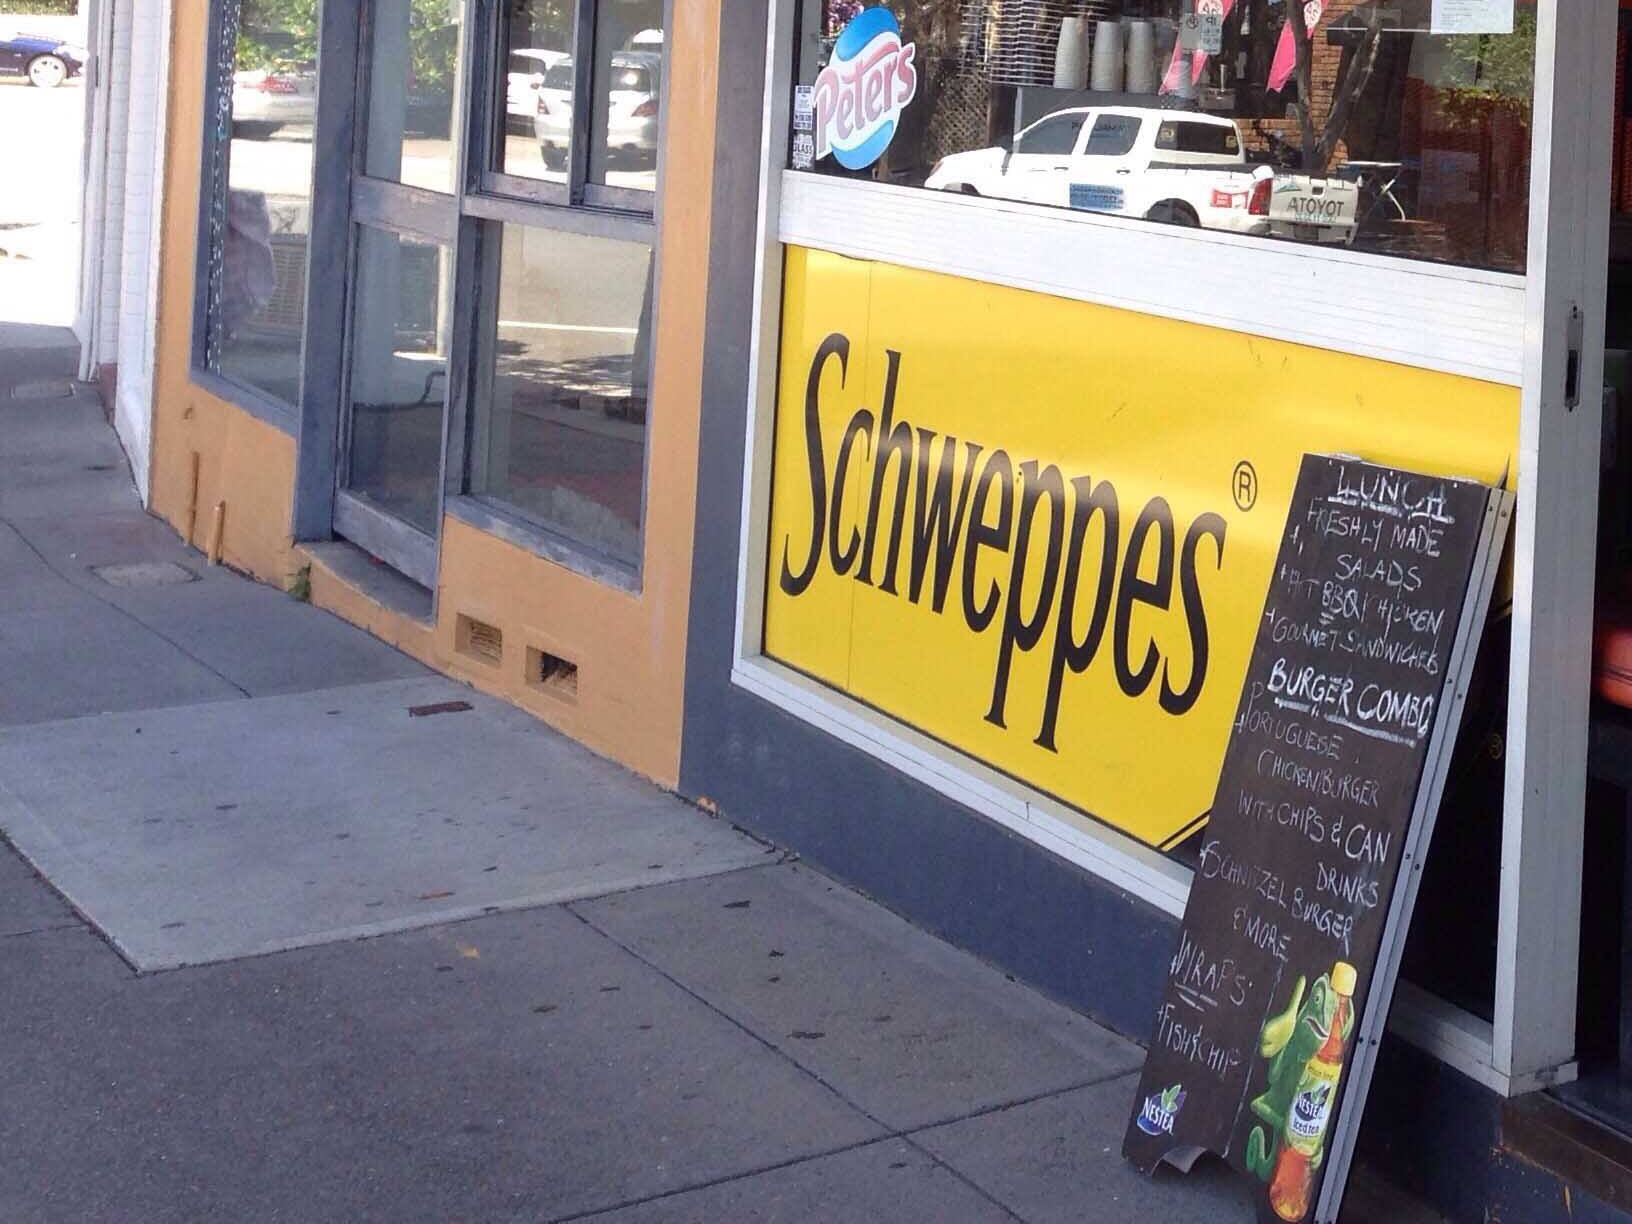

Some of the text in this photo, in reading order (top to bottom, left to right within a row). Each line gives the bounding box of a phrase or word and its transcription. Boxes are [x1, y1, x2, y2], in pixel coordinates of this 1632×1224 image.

[814, 41, 914, 155] Peters
[1336, 465, 1446, 518] LUNCH
[779, 332, 1228, 755] Schweppes
[1307, 497, 1444, 557] FRESHLY MADE
[1335, 554, 1424, 592] SALADS
[1321, 580, 1361, 621] BBQ
[1272, 616, 1339, 652] GOURMET
[1267, 657, 1435, 740] BURGER COMBO
[1320, 767, 1382, 808] BURGER
[1276, 802, 1325, 843] CHIPS
[1344, 824, 1391, 864] CAN
[1315, 861, 1379, 908] DRINKS
[1244, 916, 1293, 963] MORE
[1291, 887, 1354, 950] BURGER
[1141, 1095, 1175, 1136] NESTEA
